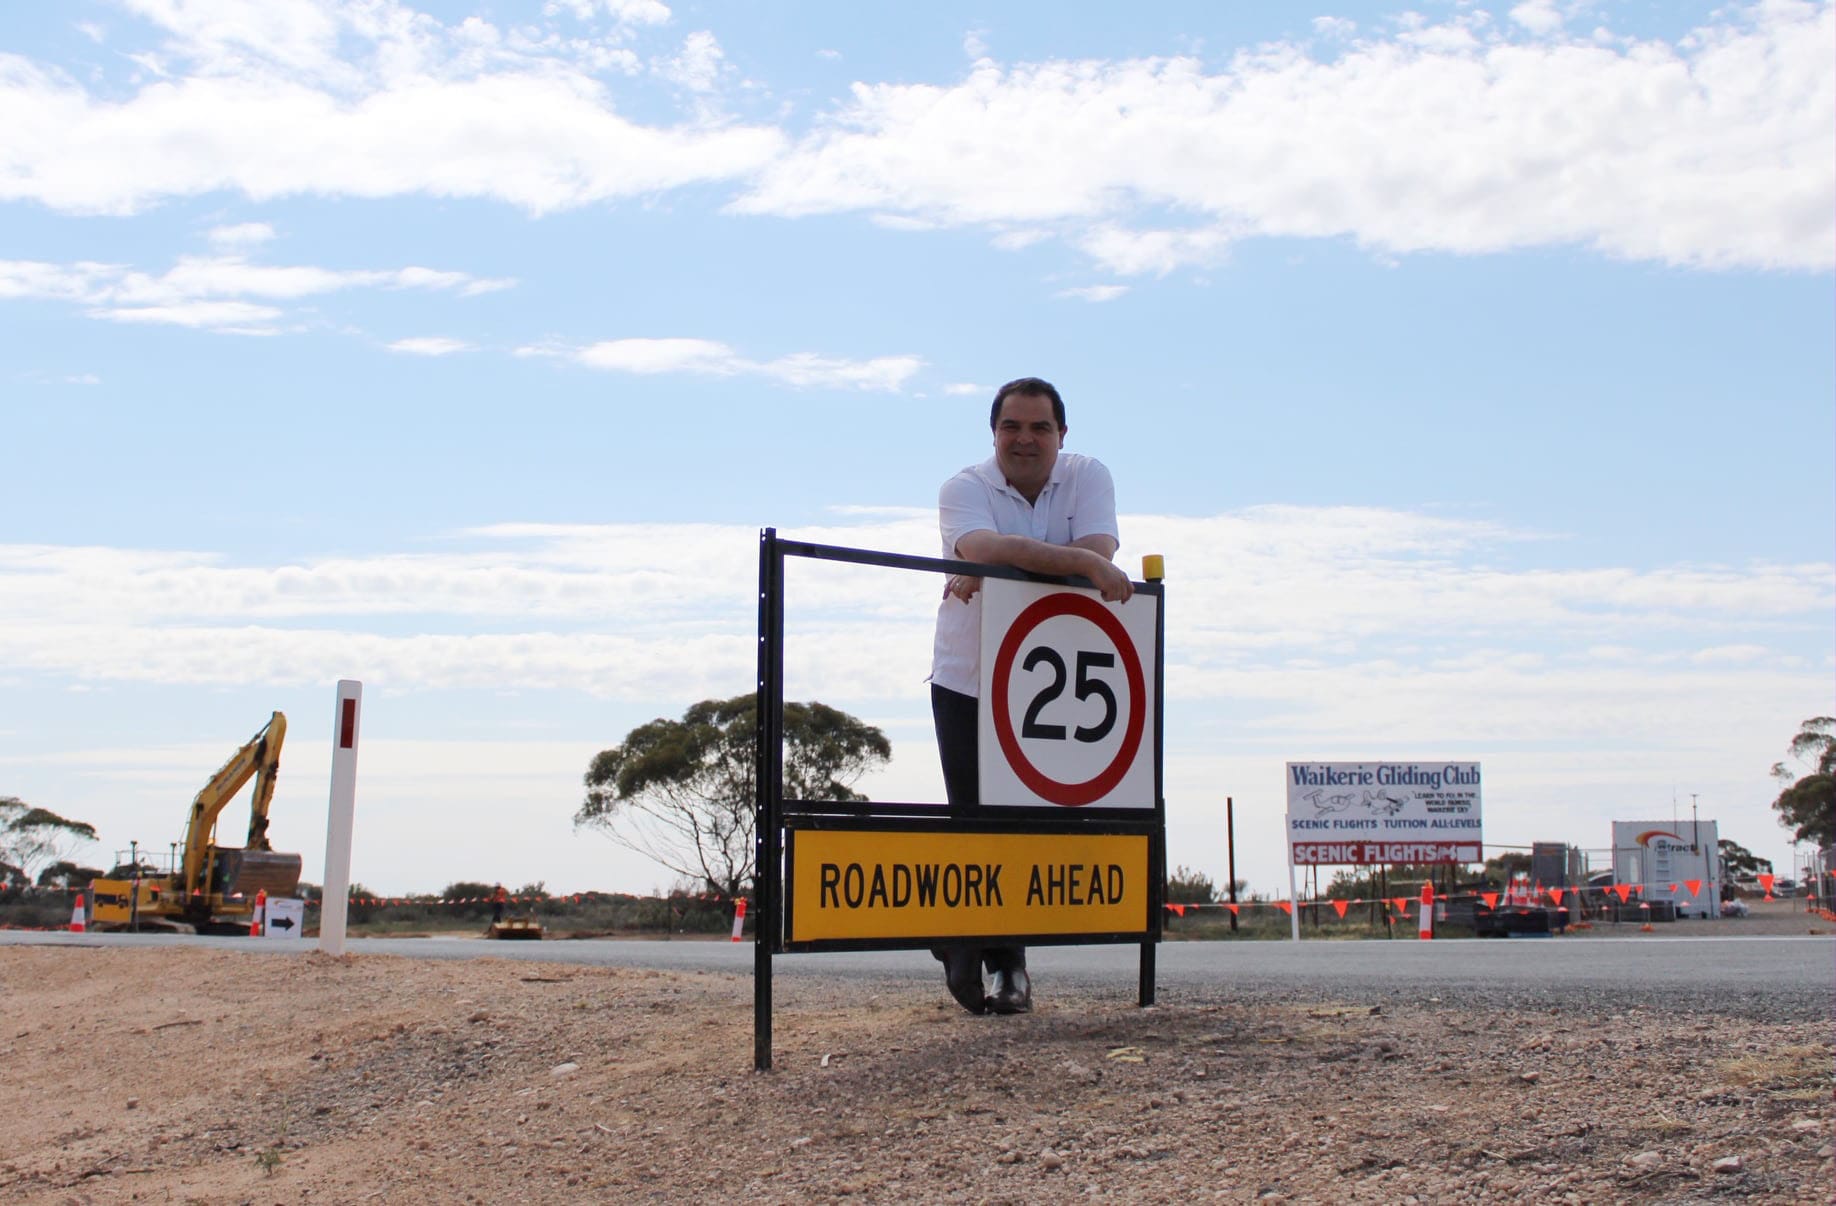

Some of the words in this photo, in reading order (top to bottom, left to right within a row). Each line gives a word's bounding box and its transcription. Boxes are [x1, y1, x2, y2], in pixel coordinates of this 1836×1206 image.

[1022, 646, 1117, 743] 25
[1291, 765, 1373, 786] Waikerie
[1376, 765, 1441, 790] Gliding
[1443, 765, 1481, 786] Club
[1292, 819, 1329, 829] SCENIC
[1333, 819, 1378, 829] FLIGHTS
[1384, 819, 1427, 829] TUITION
[1295, 845, 1358, 862] SCENIC
[1363, 845, 1437, 862] FLIGHTS
[820, 863, 1003, 909] ROADWORK
[1026, 864, 1124, 906] AHEAD
